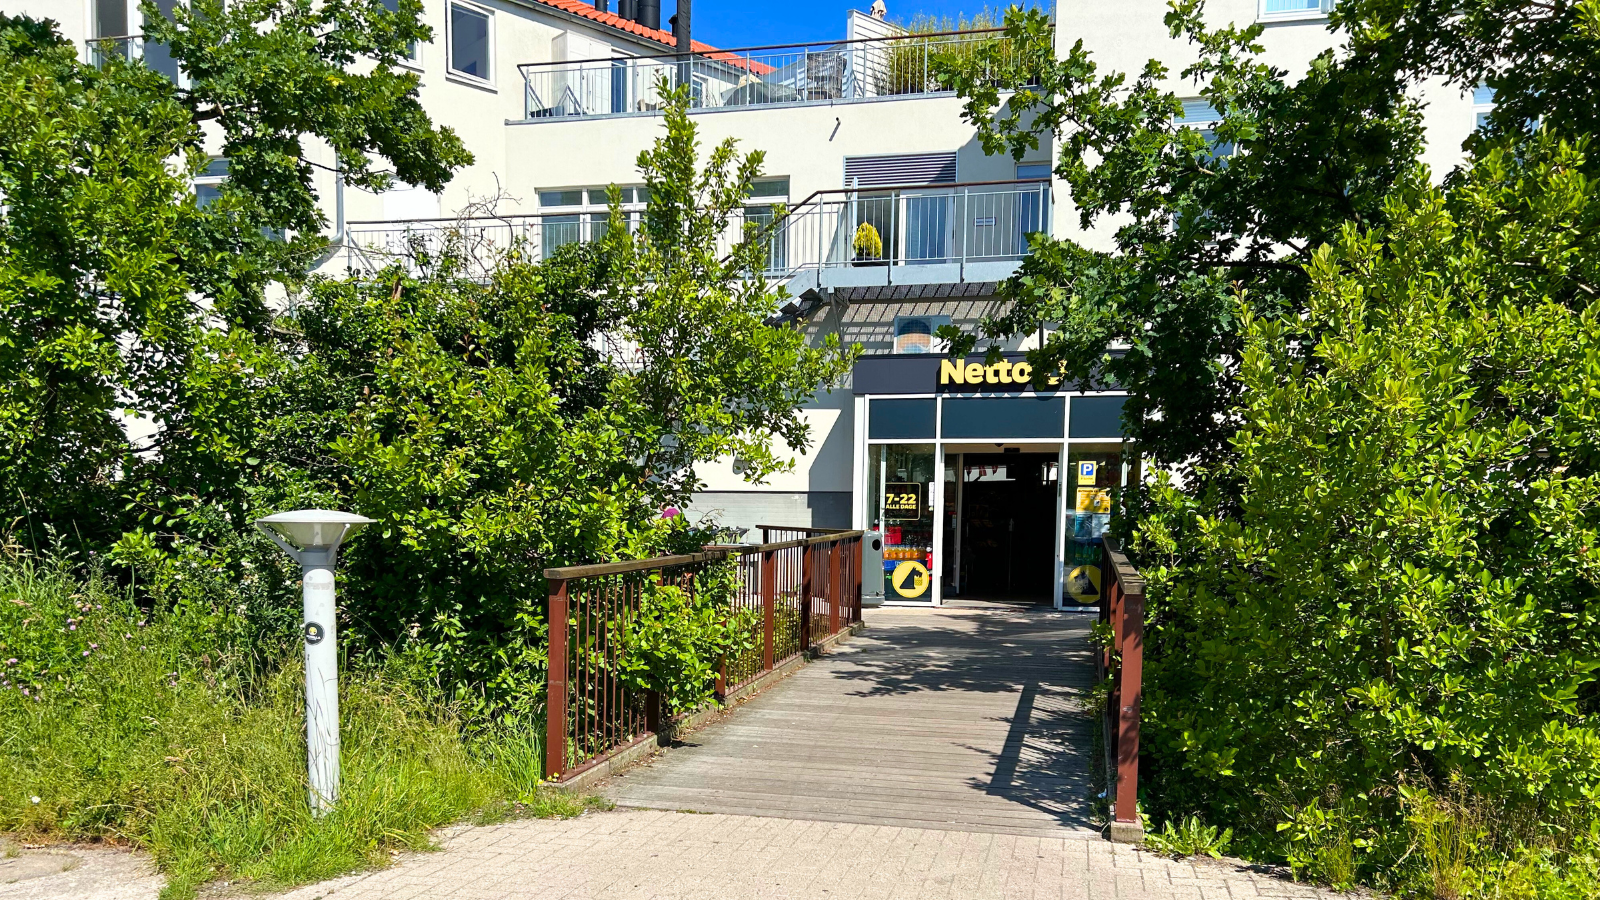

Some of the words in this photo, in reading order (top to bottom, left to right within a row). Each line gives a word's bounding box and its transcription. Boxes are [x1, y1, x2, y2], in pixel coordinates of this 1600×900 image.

[940, 358, 1033, 384] Netto
[1083, 464, 1092, 475] P
[886, 493, 917, 504] 7-22
